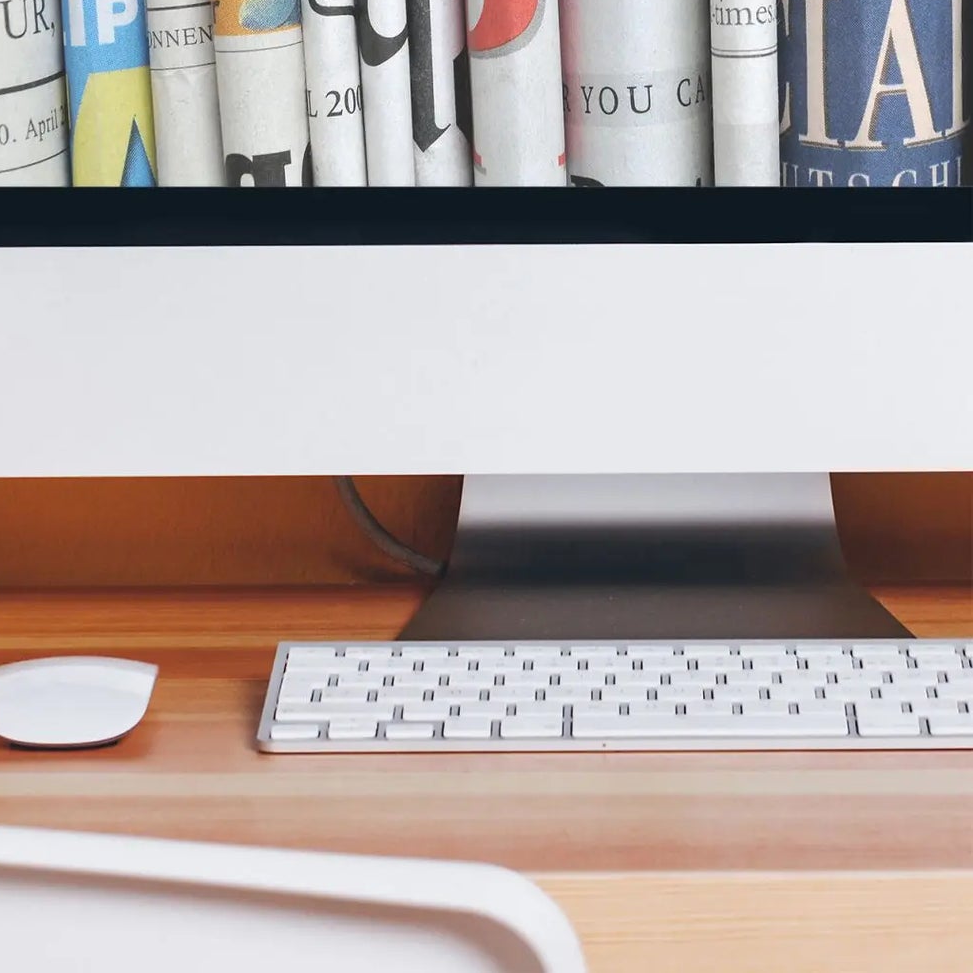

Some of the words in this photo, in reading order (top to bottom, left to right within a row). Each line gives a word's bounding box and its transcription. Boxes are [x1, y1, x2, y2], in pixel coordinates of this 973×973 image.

[580, 84, 653, 115] YOU
[677, 74, 711, 107] CA
[25, 108, 58, 142] April
